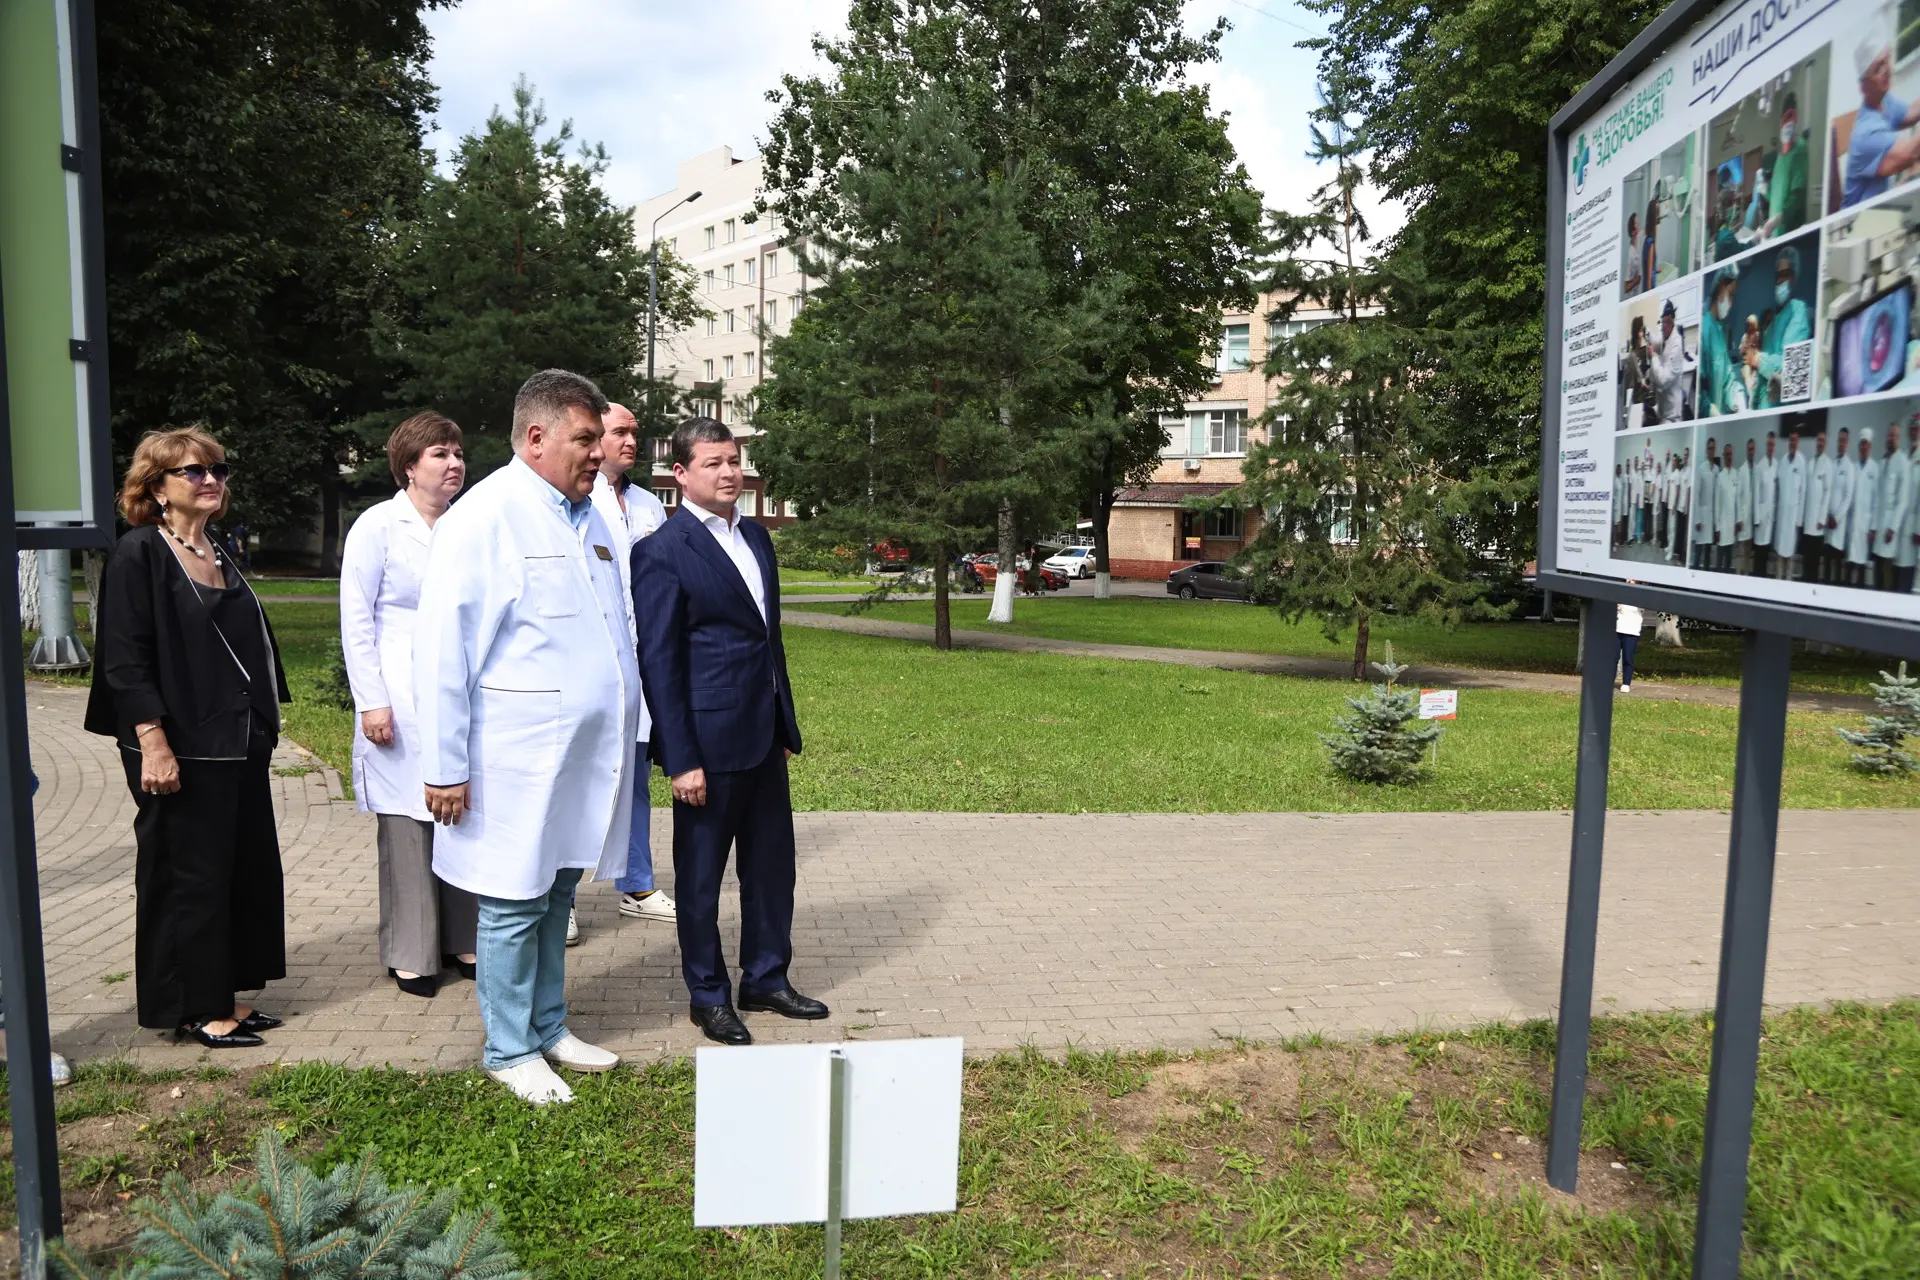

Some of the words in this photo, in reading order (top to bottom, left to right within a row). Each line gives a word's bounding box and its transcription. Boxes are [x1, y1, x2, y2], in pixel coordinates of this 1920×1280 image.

[1692, 22, 1744, 86] НАШИ
[1748, 0, 1801, 50] ДОС
[1592, 125, 1603, 146] НА
[1604, 97, 1635, 135] СТРАЖЕ
[1636, 67, 1673, 110] ВАШЕГО
[1596, 92, 1664, 168] ЗДОРОВЬЯ!
